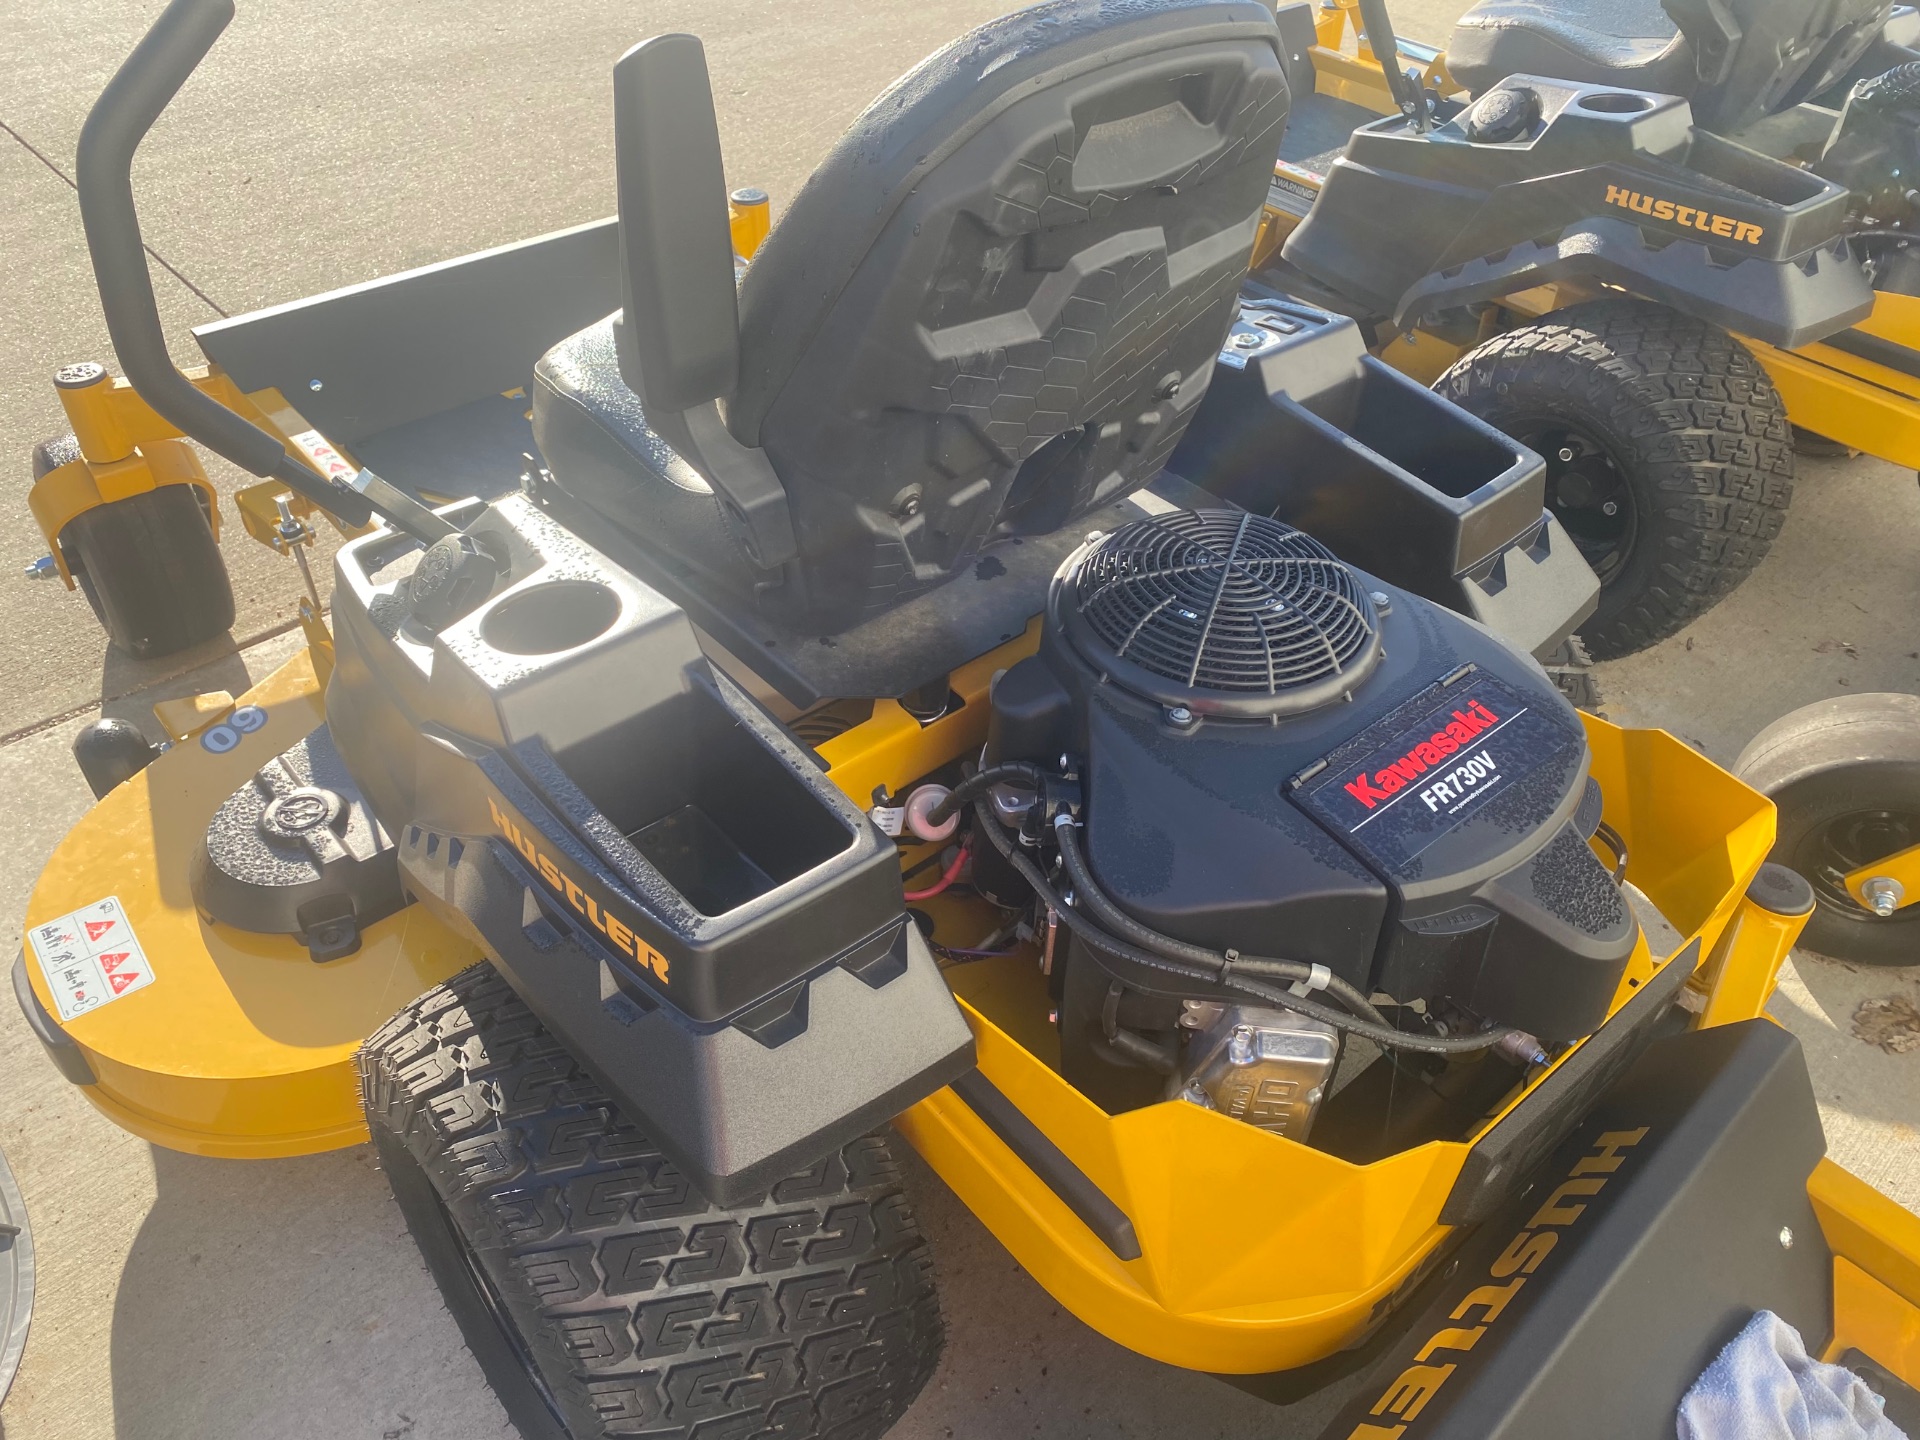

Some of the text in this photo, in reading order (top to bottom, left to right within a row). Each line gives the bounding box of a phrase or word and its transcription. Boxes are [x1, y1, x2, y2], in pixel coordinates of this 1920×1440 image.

[1605, 185, 1764, 244] HUSTLER
[1344, 700, 1499, 809] Kawasaki
[1420, 750, 1496, 812] FR730V
[488, 797, 670, 985] HUSTLER
